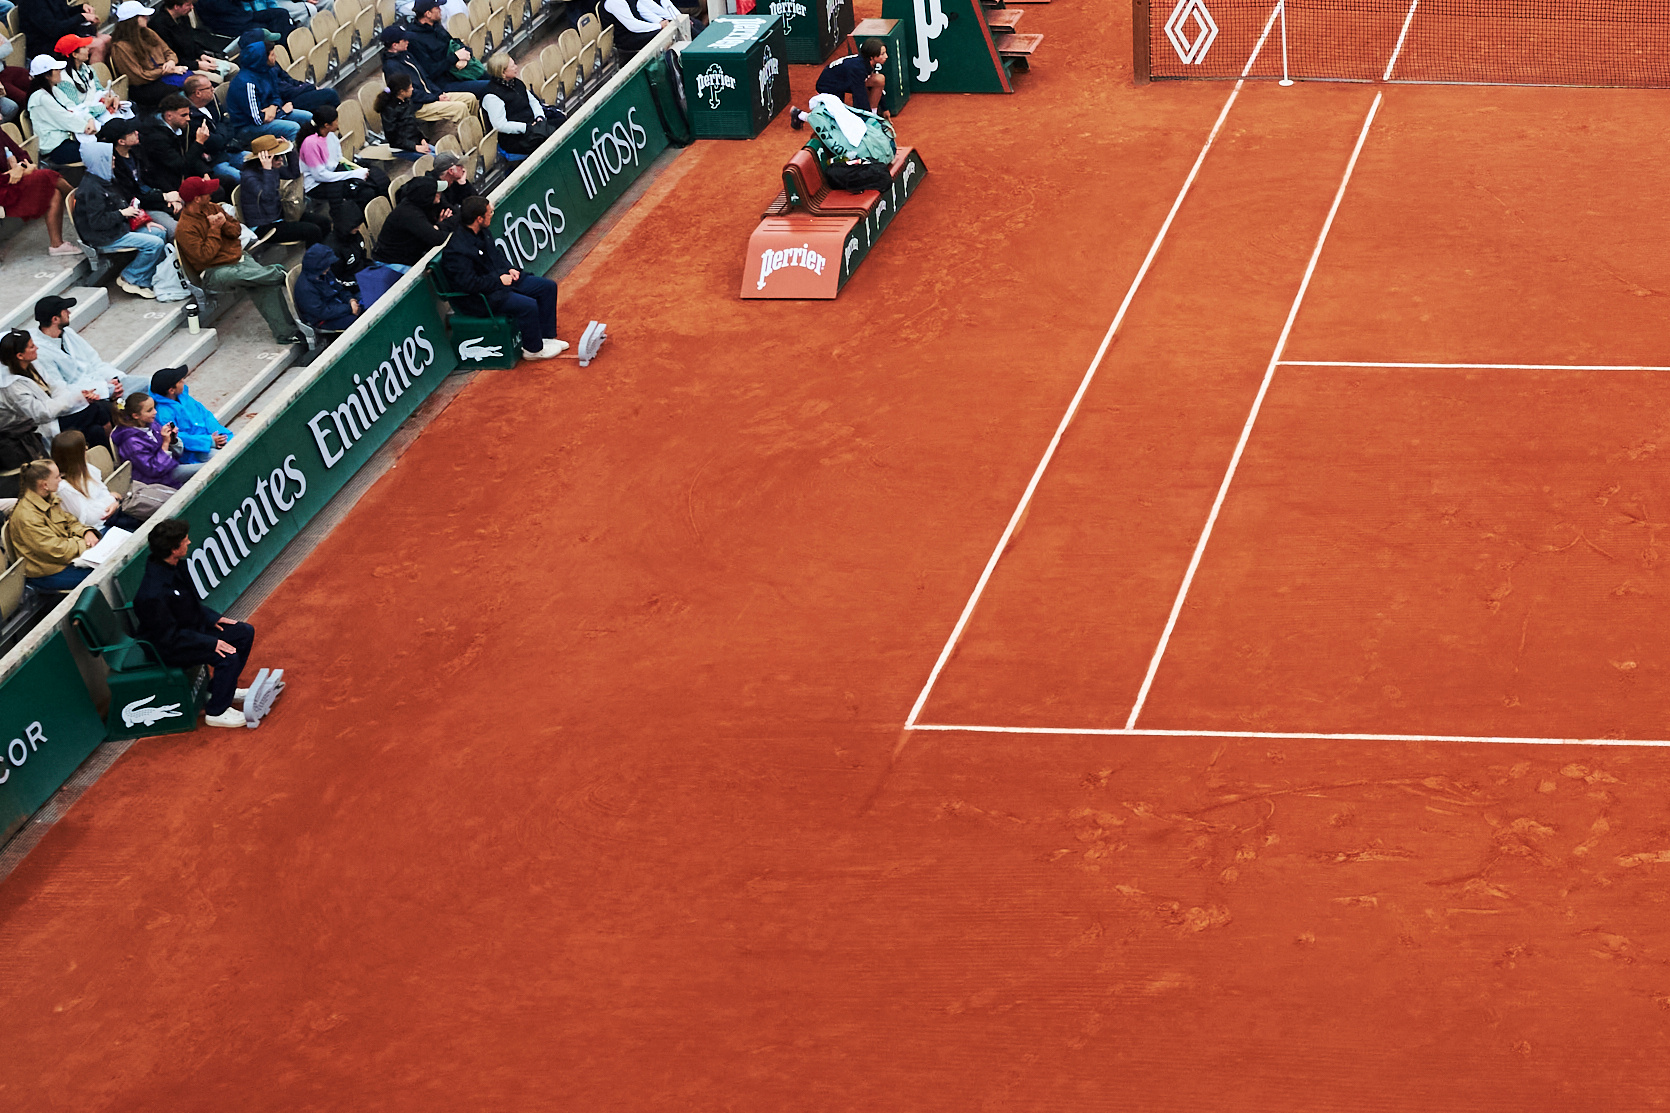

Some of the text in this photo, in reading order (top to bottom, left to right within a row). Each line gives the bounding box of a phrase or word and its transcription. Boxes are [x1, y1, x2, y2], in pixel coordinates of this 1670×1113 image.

[572, 106, 648, 200] Infosys
[494, 188, 566, 269] nfosys
[256, 352, 280, 360] 02
[307, 325, 435, 469] Emirates
[187, 453, 307, 600] mirates
